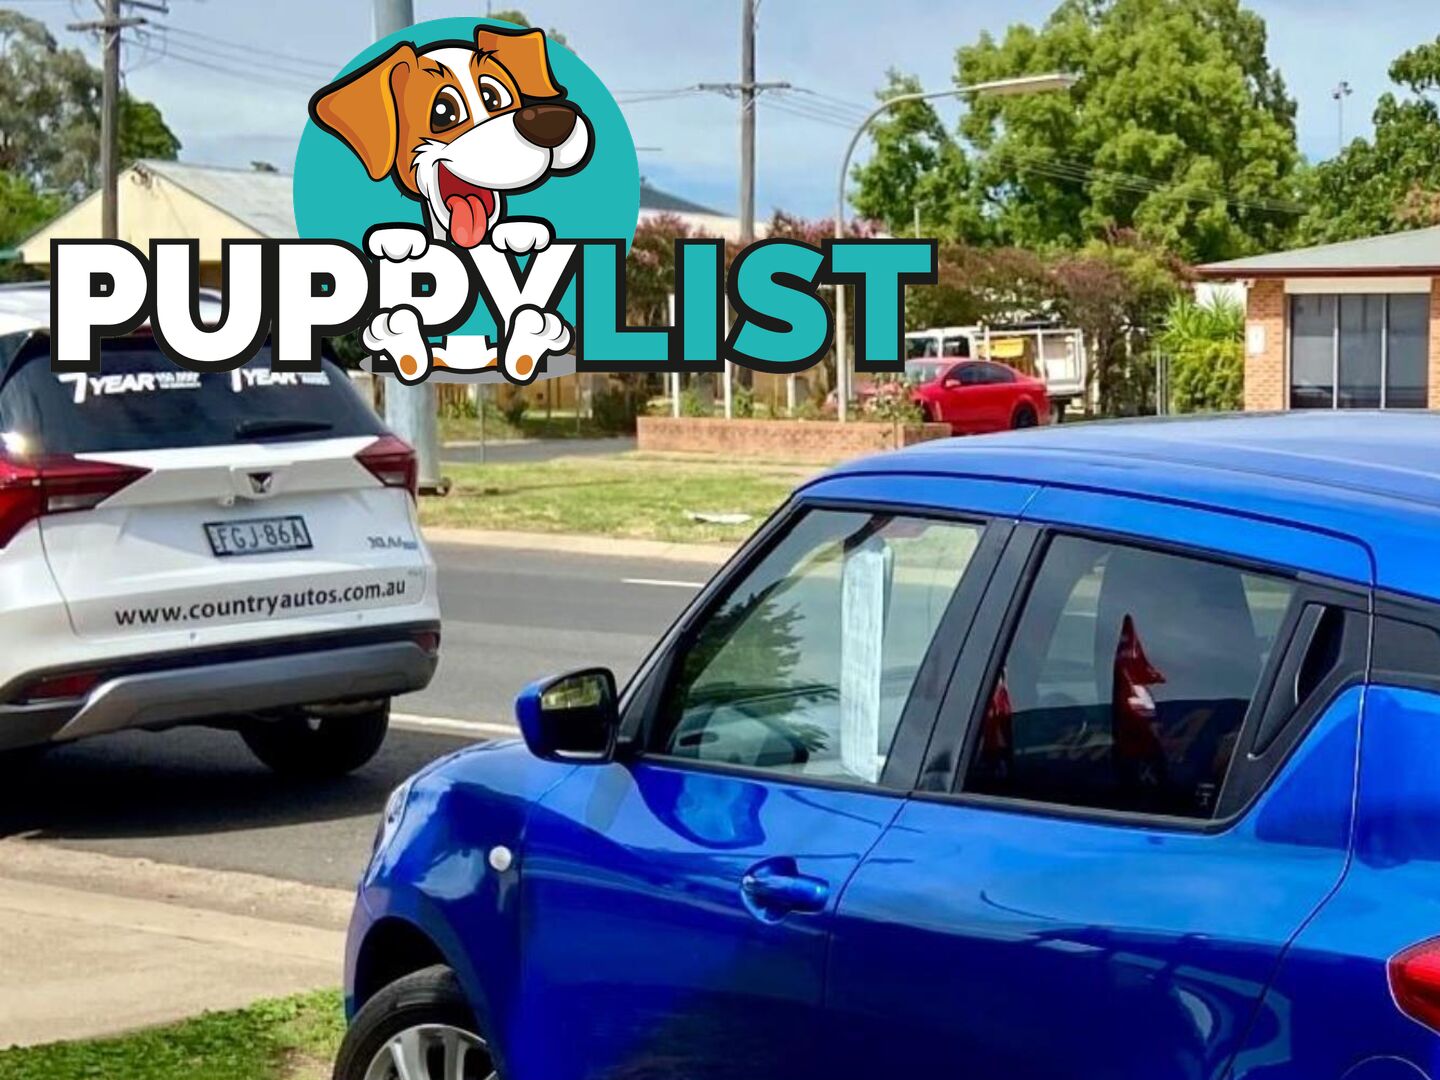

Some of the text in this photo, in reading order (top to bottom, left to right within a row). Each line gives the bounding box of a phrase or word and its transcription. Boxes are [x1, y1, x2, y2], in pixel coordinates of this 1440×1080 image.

[59, 373, 87, 403] 7
[90, 373, 155, 395] YEAR
[242, 368, 298, 386] YEAR
[115, 579, 406, 627] www.countryautos.com.au
